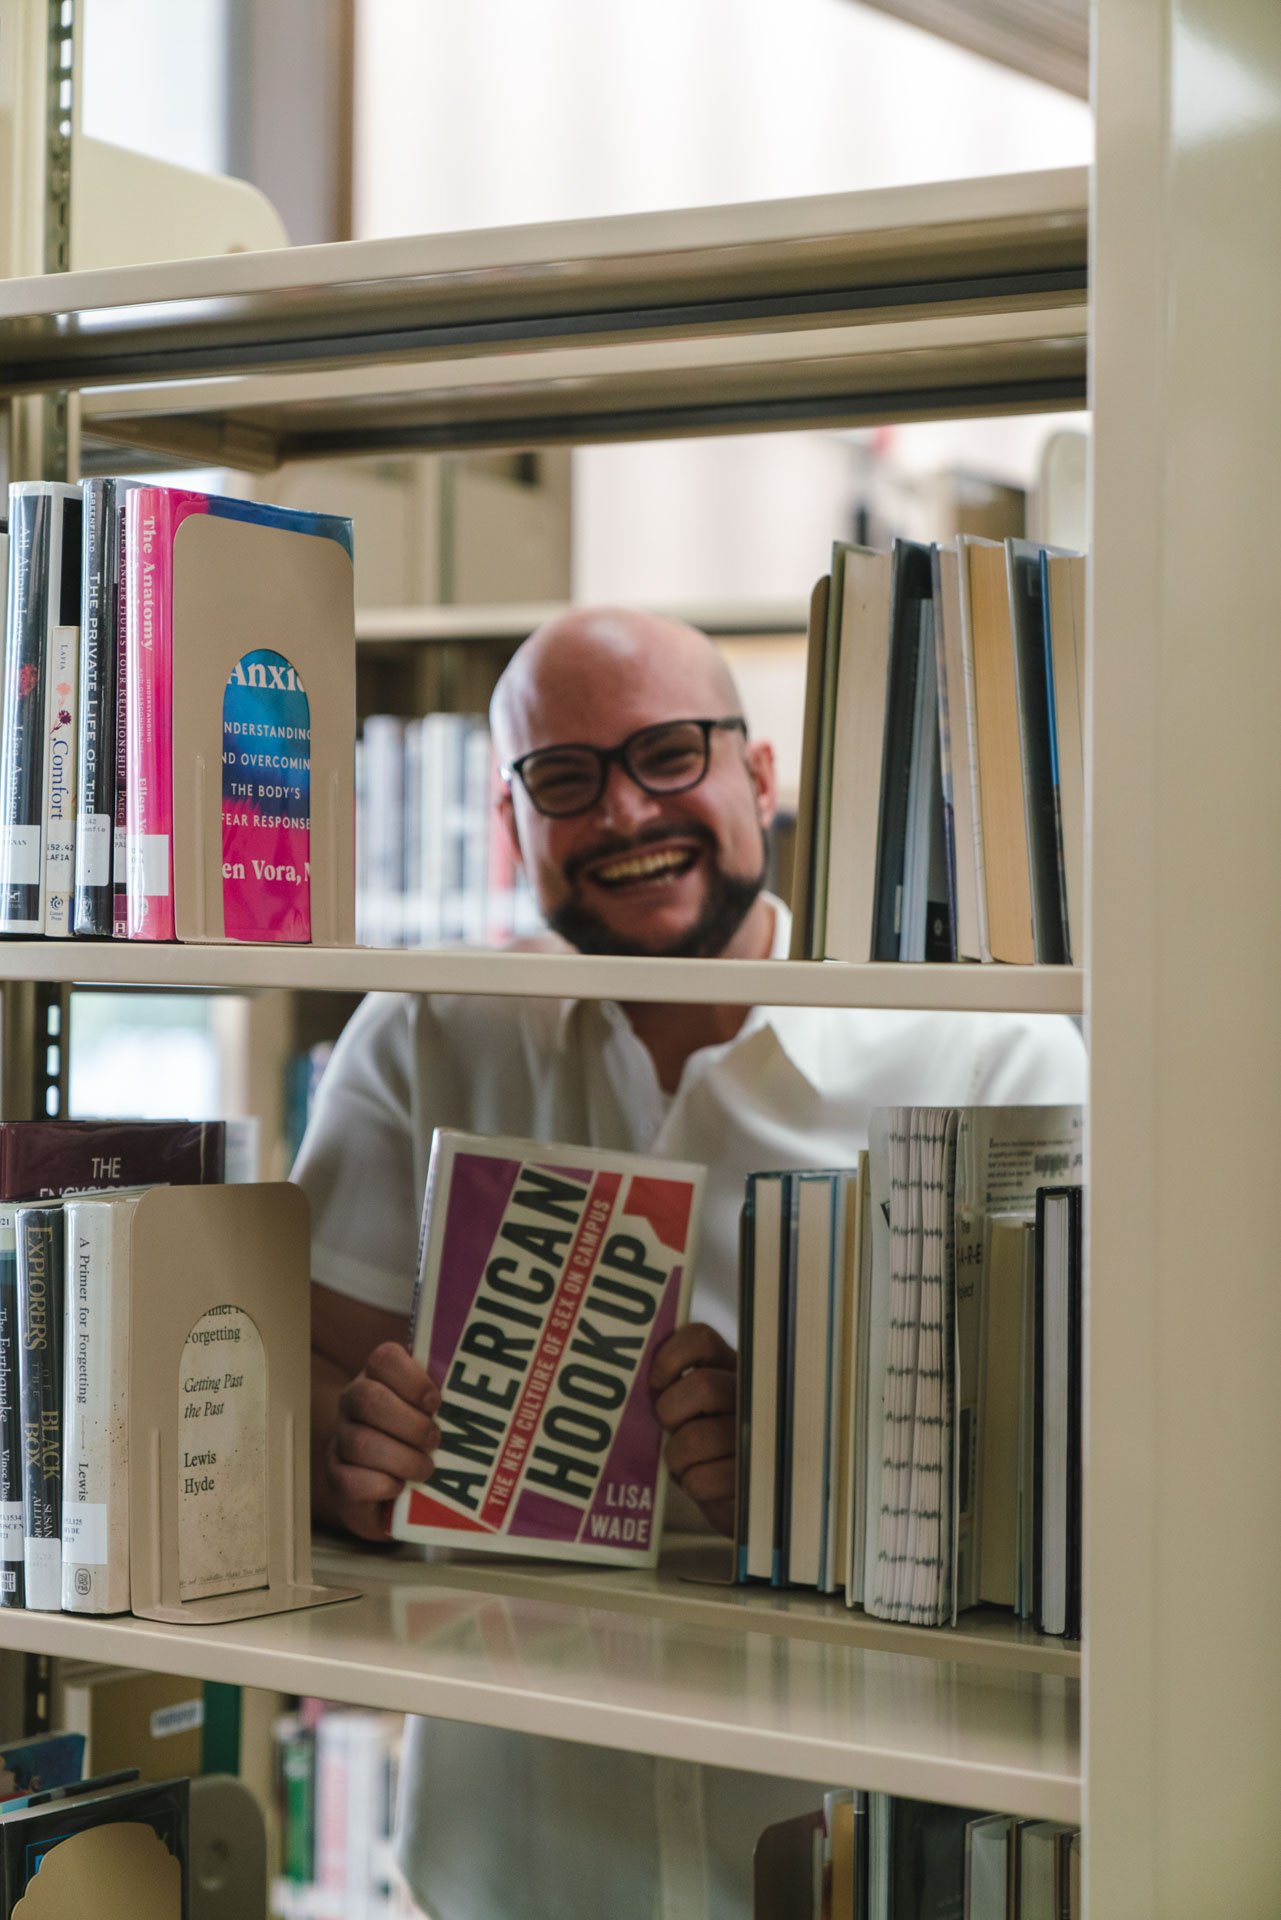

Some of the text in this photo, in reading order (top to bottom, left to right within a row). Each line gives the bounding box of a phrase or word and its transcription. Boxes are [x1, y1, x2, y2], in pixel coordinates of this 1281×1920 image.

[140, 515, 157, 651] The Anatomy
[118, 652, 127, 684] YOUR
[85, 571, 101, 815] THE PRIVATE LIFE OF THE
[117, 688, 127, 777] RELATIONSHIP
[51, 739, 69, 820] Comfort
[240, 754, 311, 771] OVERCOMIN
[117, 790, 127, 819] PALEG
[137, 777, 148, 814] Ellen
[231, 783, 301, 800] THE BODY'S
[253, 815, 311, 830] RESPONSE
[251, 859, 302, 886] Vora,
[91, 1156, 122, 1179] THE
[24, 1225, 53, 1350] EXPLORERS
[77, 1237, 90, 1404] A Primer for Forgetting
[423, 1166, 591, 1513] AMERICAN
[488, 1199, 611, 1506] THE NEW CULTURE OF SEX ON CAMPUS
[31, 1362, 40, 1398] THE
[184, 1373, 244, 1394] Getting Past
[524, 1232, 669, 1500] HOOKUP
[184, 1401, 225, 1419] the Past
[25, 1422, 41, 1467] BOX
[41, 1410, 60, 1480] BLACK
[183, 1450, 217, 1468] Lewis
[0, 1448, 10, 1479] Vince
[77, 1462, 89, 1501] Lewis
[184, 1475, 216, 1496] Hyde
[605, 1482, 652, 1511] LISA
[42, 1503, 53, 1538] SUSAN
[590, 1513, 651, 1544] WADE
